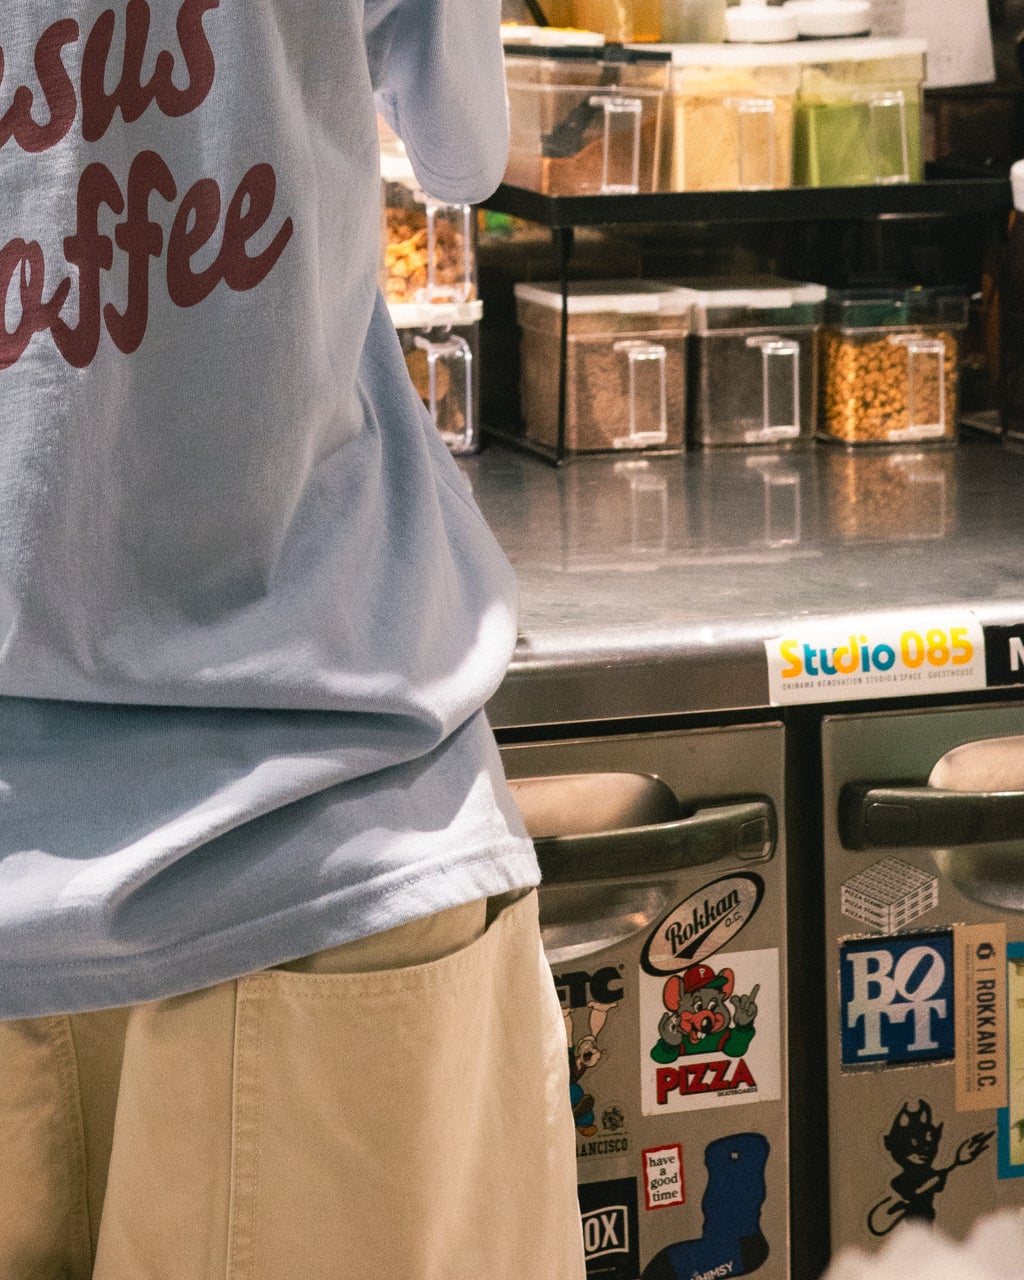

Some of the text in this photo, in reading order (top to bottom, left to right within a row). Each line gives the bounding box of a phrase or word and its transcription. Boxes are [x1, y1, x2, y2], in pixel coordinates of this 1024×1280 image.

[778, 634, 896, 679] Studio
[900, 627, 974, 670] 085
[782, 680, 815, 691] OKINAWA
[817, 677, 863, 688] RENOVATION
[899, 672, 923, 682] SPACE
[927, 668, 974, 679] GUESTHOUSE
[665, 889, 741, 956] Rokkan
[976, 979, 996, 1055] ROKKAN
[656, 1058, 757, 1106] PIZZA
[648, 1155, 676, 1168] have
[659, 1167, 667, 1177] a
[650, 1172, 679, 1191] good
[652, 1189, 679, 1202] time
